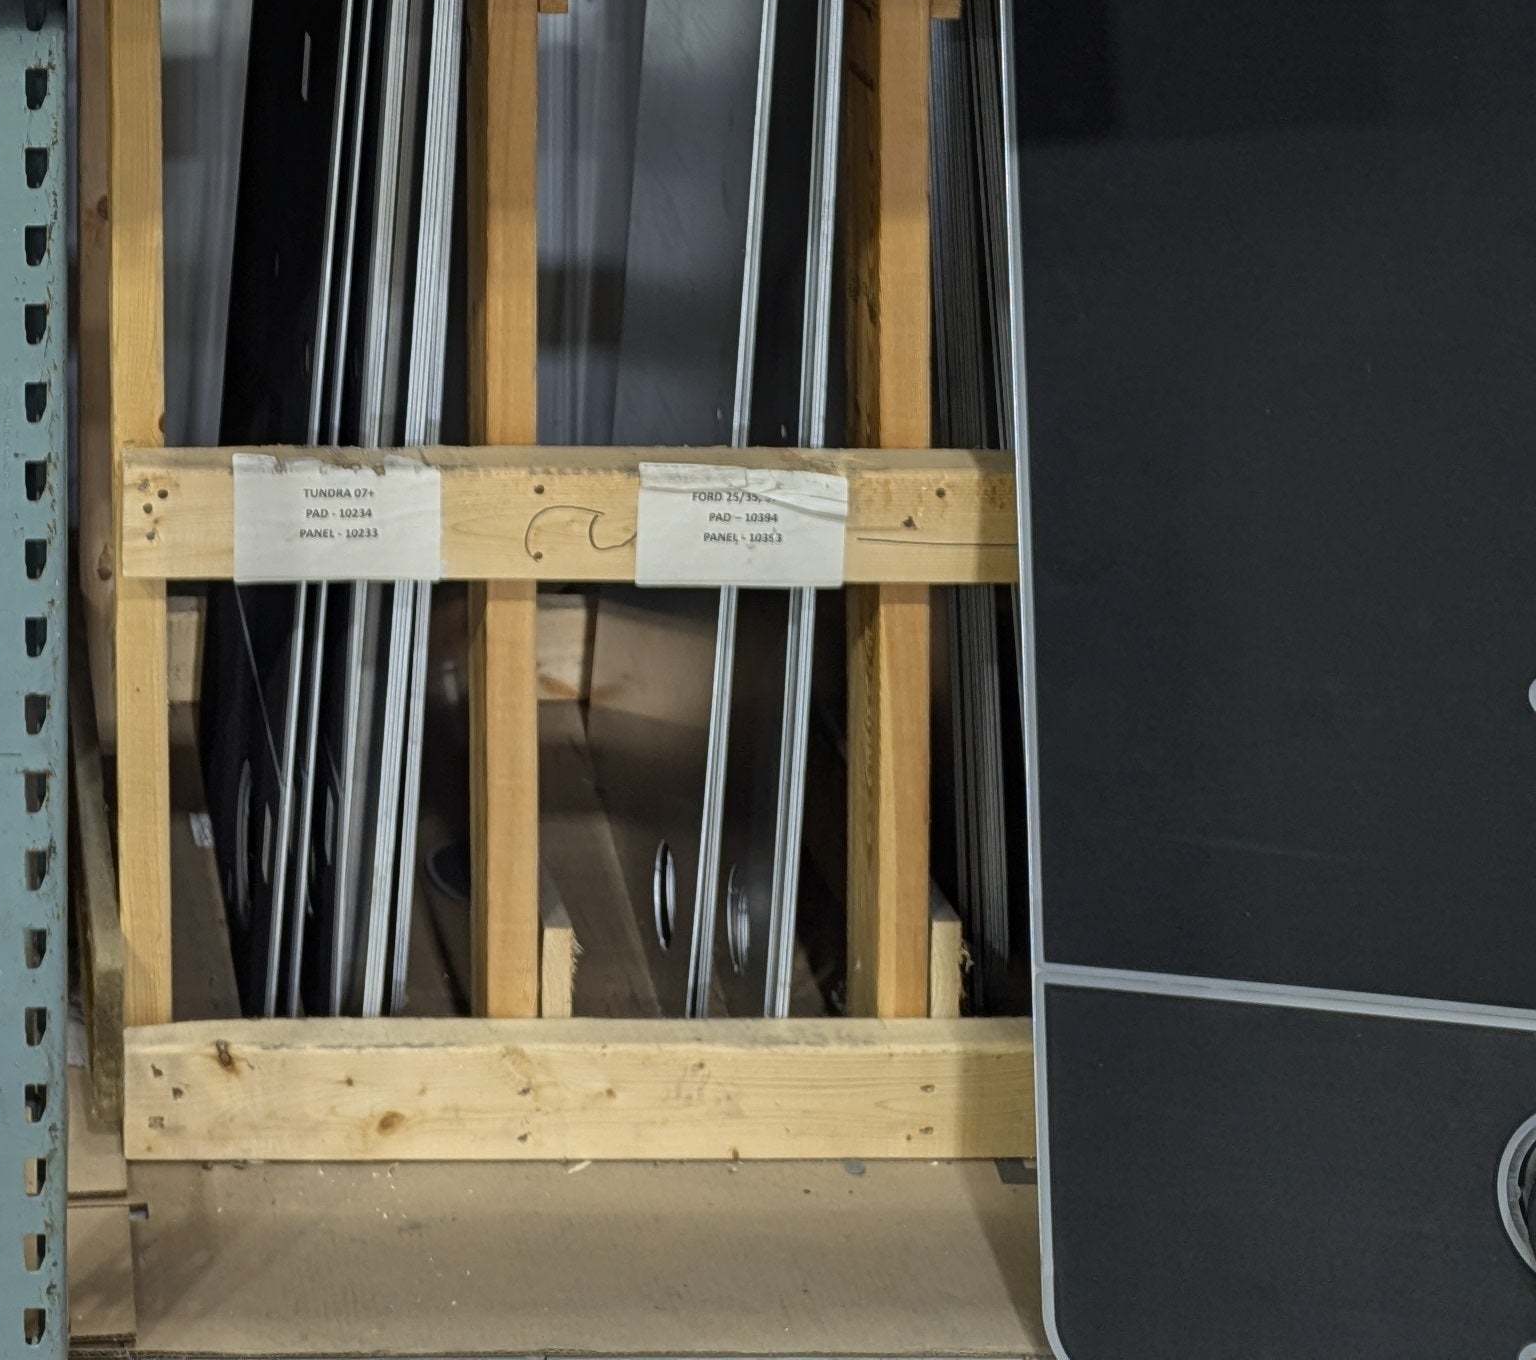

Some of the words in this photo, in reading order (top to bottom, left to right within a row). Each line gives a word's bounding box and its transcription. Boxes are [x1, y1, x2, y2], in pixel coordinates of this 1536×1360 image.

[303, 488, 353, 499] TUNDRA
[353, 488, 375, 499] 07+
[691, 491, 723, 503] FORD
[305, 508, 330, 519] PAD
[339, 508, 373, 519] 10234
[708, 512, 733, 525] PAD
[745, 512, 779, 524] 10394
[299, 528, 335, 540] PANEL
[345, 527, 379, 540] 10233
[703, 532, 739, 545] PANEL
